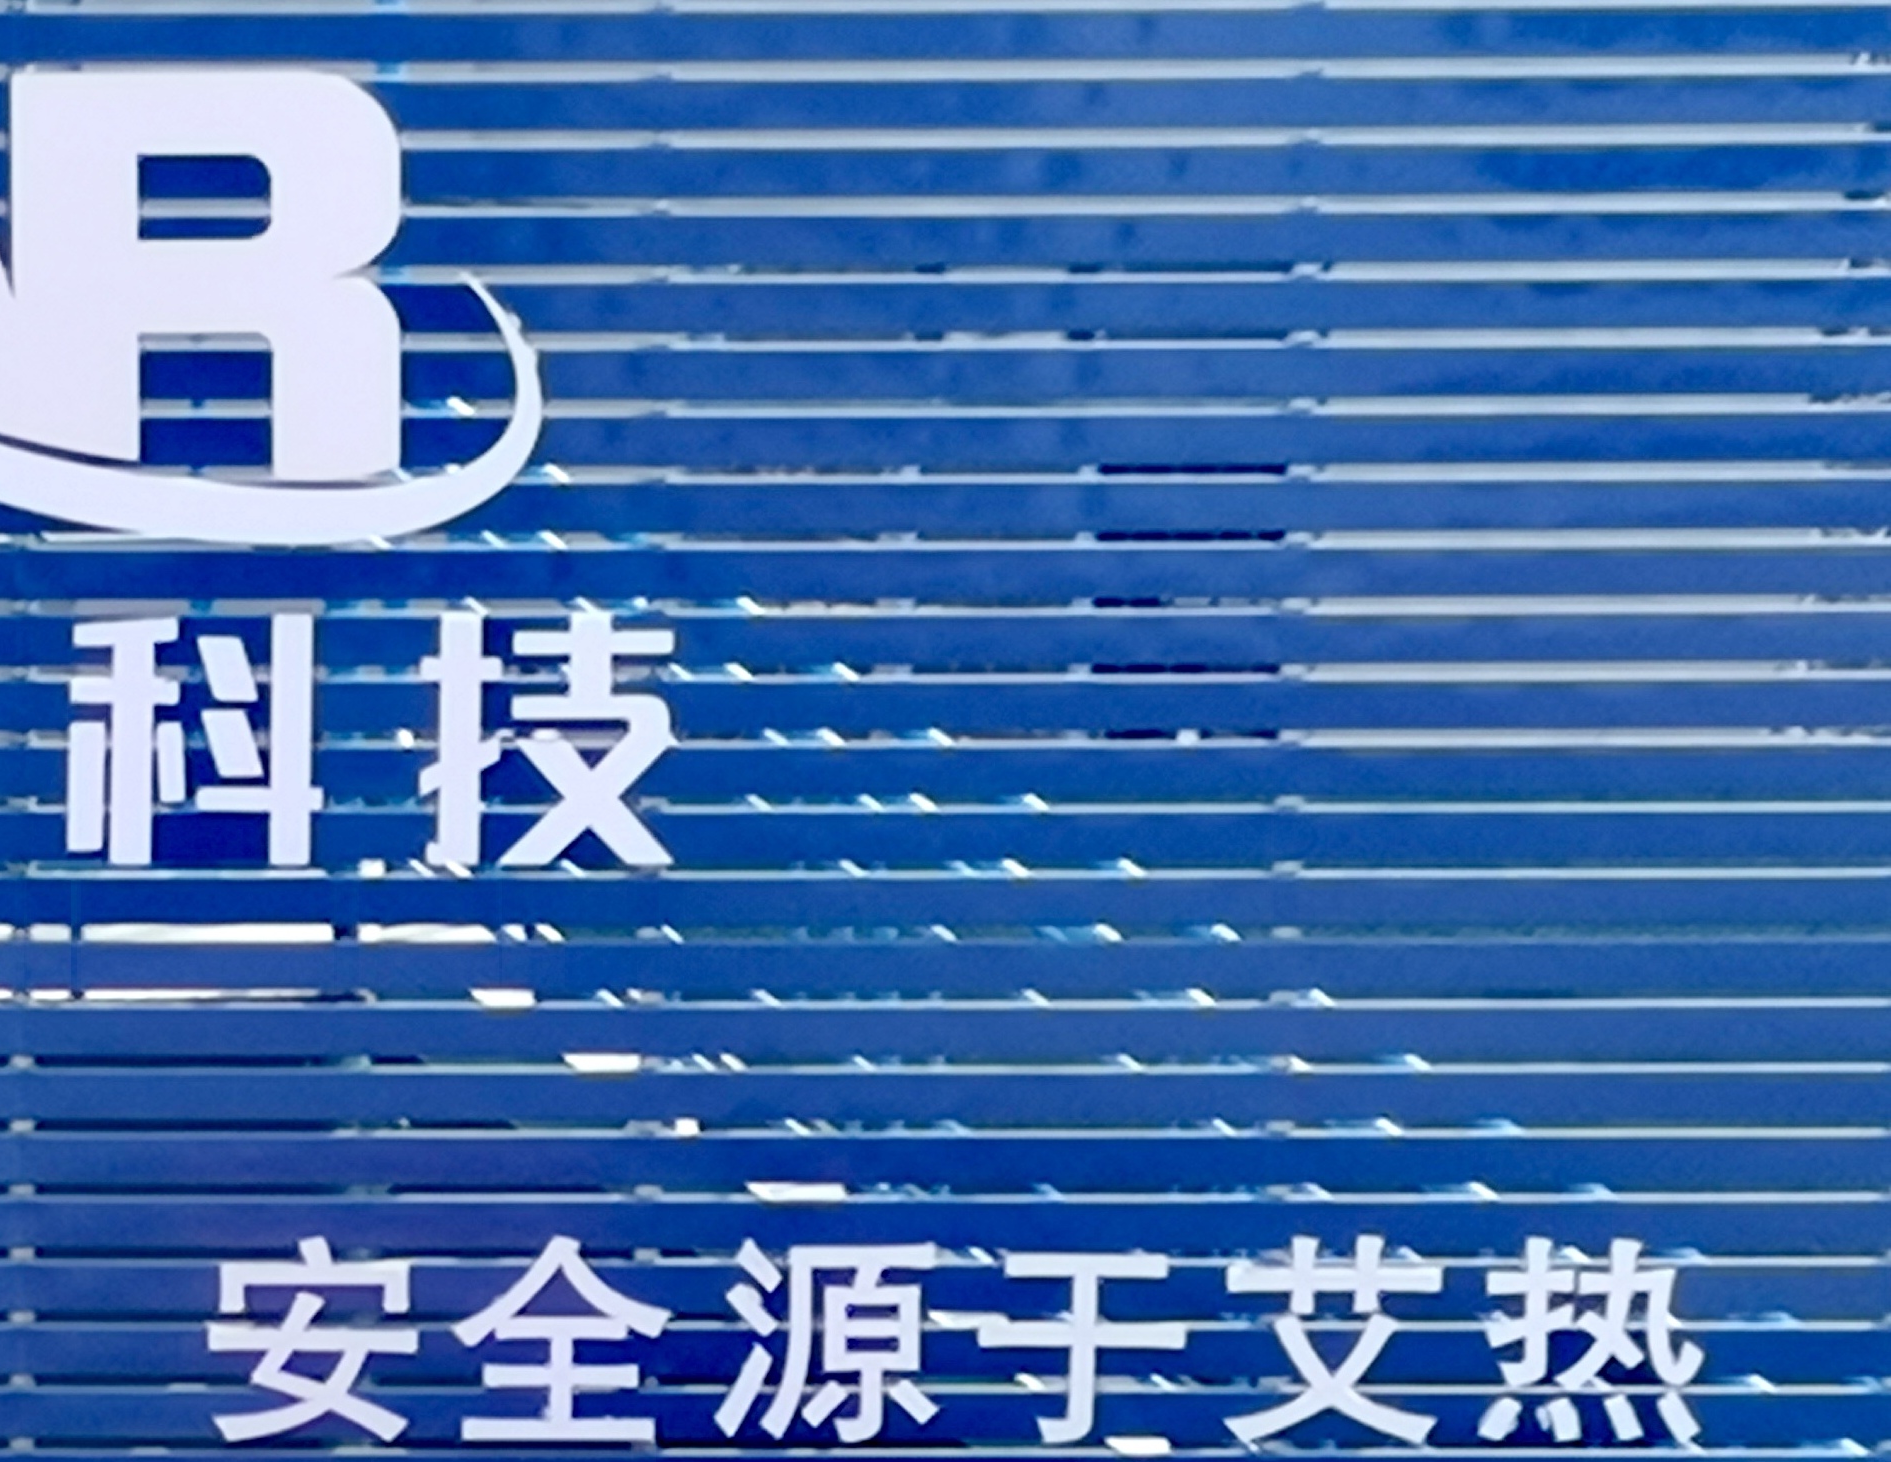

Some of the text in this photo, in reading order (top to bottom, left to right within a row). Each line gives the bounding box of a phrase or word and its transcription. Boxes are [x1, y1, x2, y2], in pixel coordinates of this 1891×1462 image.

[205, 1234, 1704, 1447] 安全源于艾热
